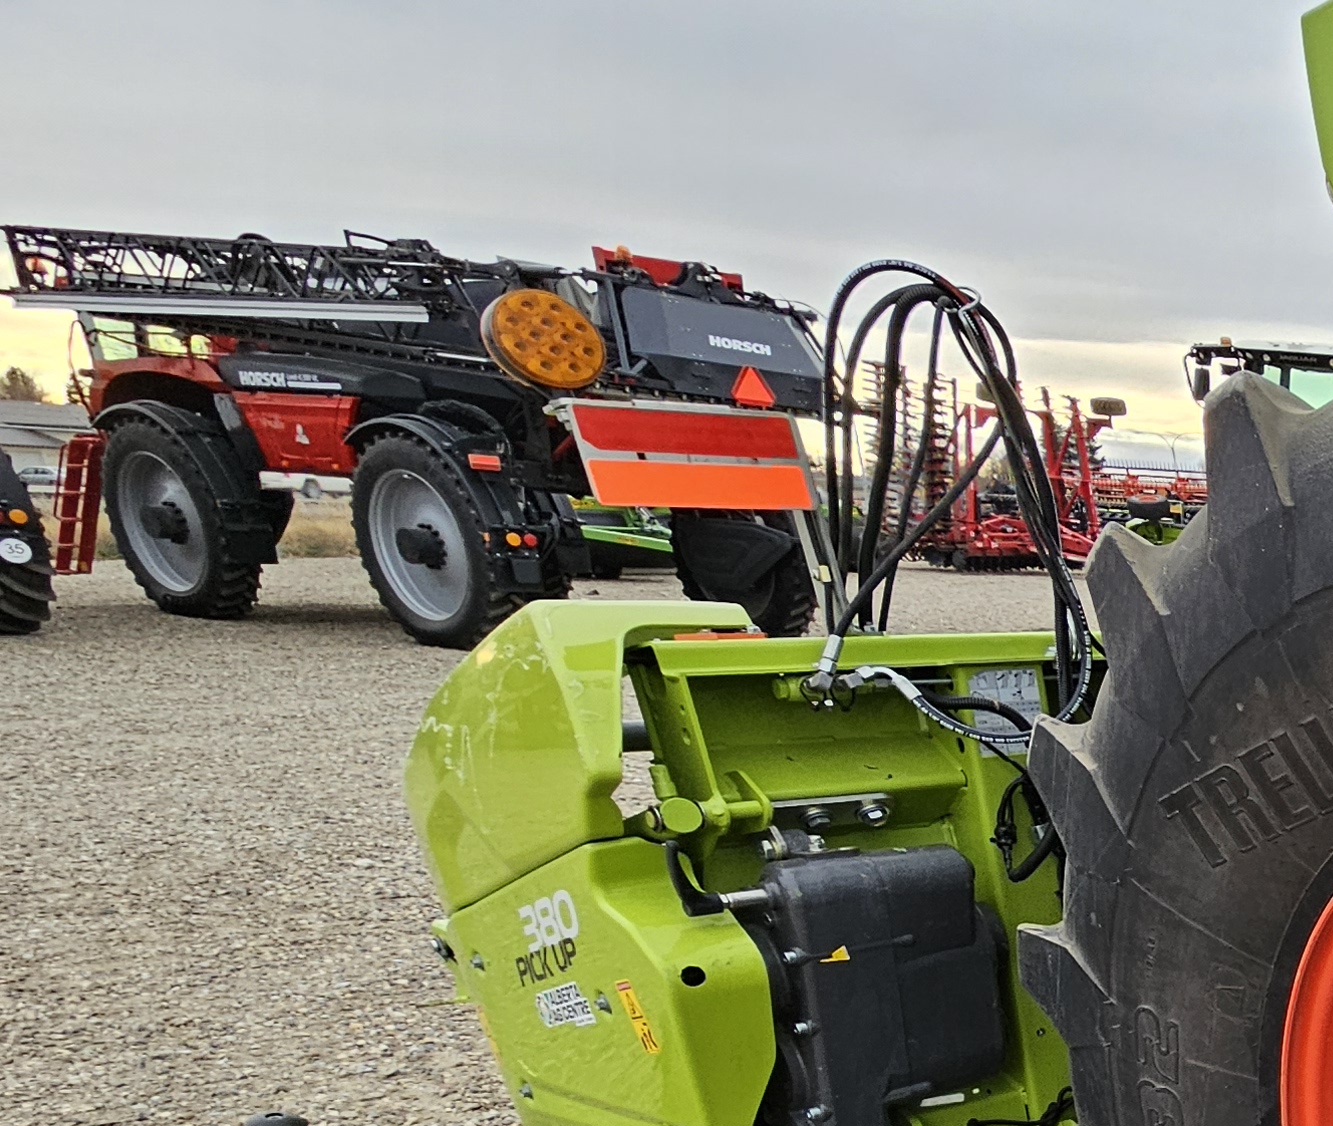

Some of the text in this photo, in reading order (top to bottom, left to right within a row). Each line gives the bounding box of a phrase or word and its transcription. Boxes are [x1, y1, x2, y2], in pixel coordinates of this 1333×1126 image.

[708, 335, 772, 356] HORSCH
[239, 371, 286, 387] HORSCH
[5, 544, 24, 554] 35
[518, 889, 579, 953] 380
[515, 937, 577, 987] PICK UP
